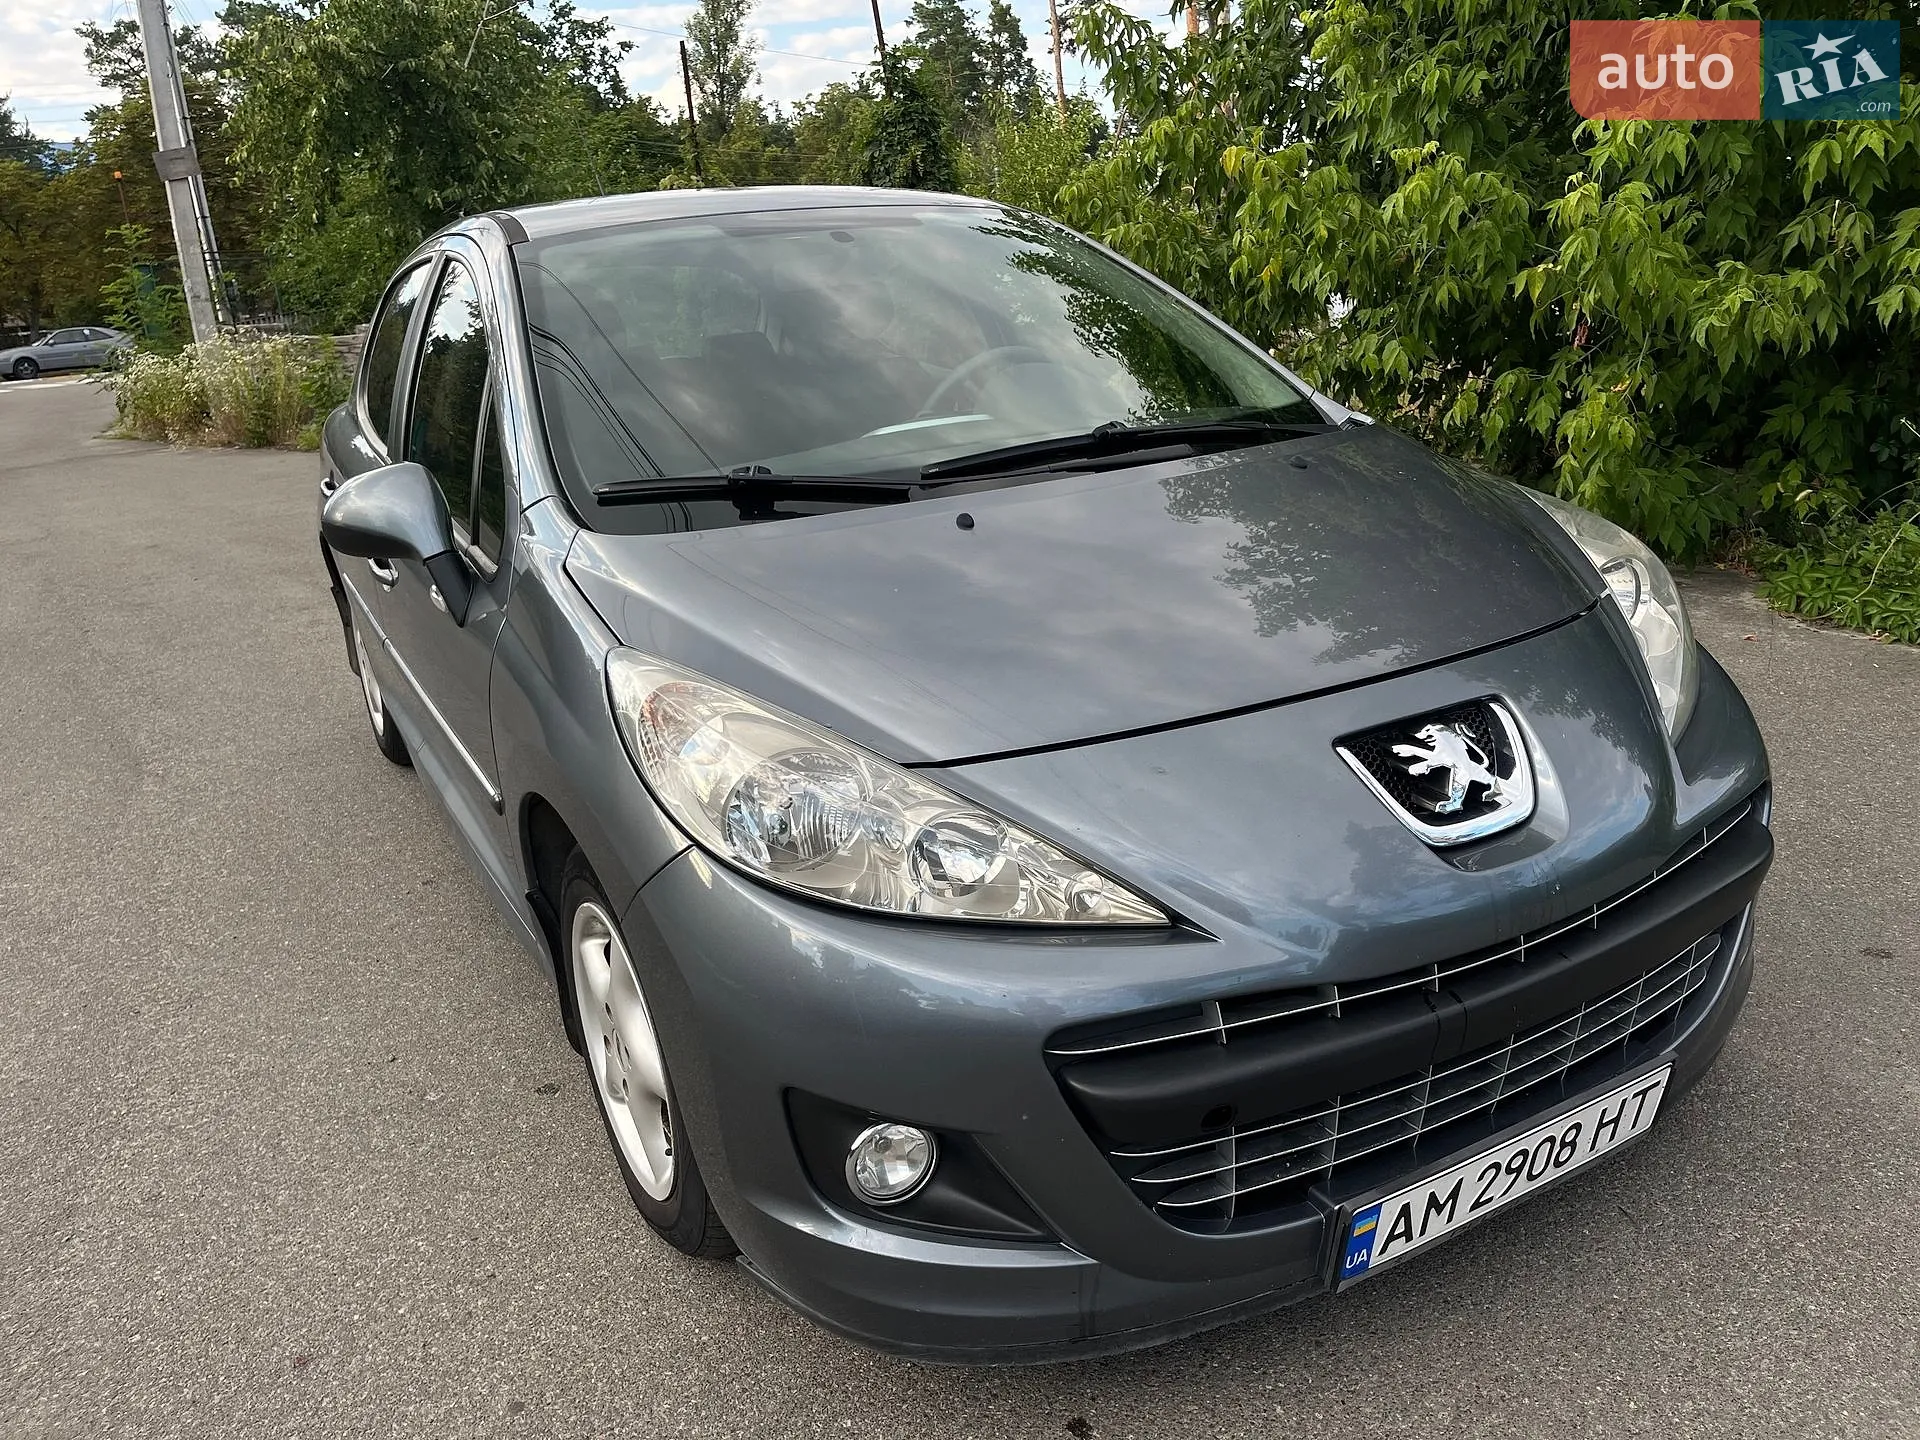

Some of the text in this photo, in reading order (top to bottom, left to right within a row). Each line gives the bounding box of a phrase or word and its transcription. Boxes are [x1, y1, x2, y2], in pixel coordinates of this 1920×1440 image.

[1377, 1080, 1661, 1256] AM 2908 HT
[1346, 1248, 1368, 1270] UA
